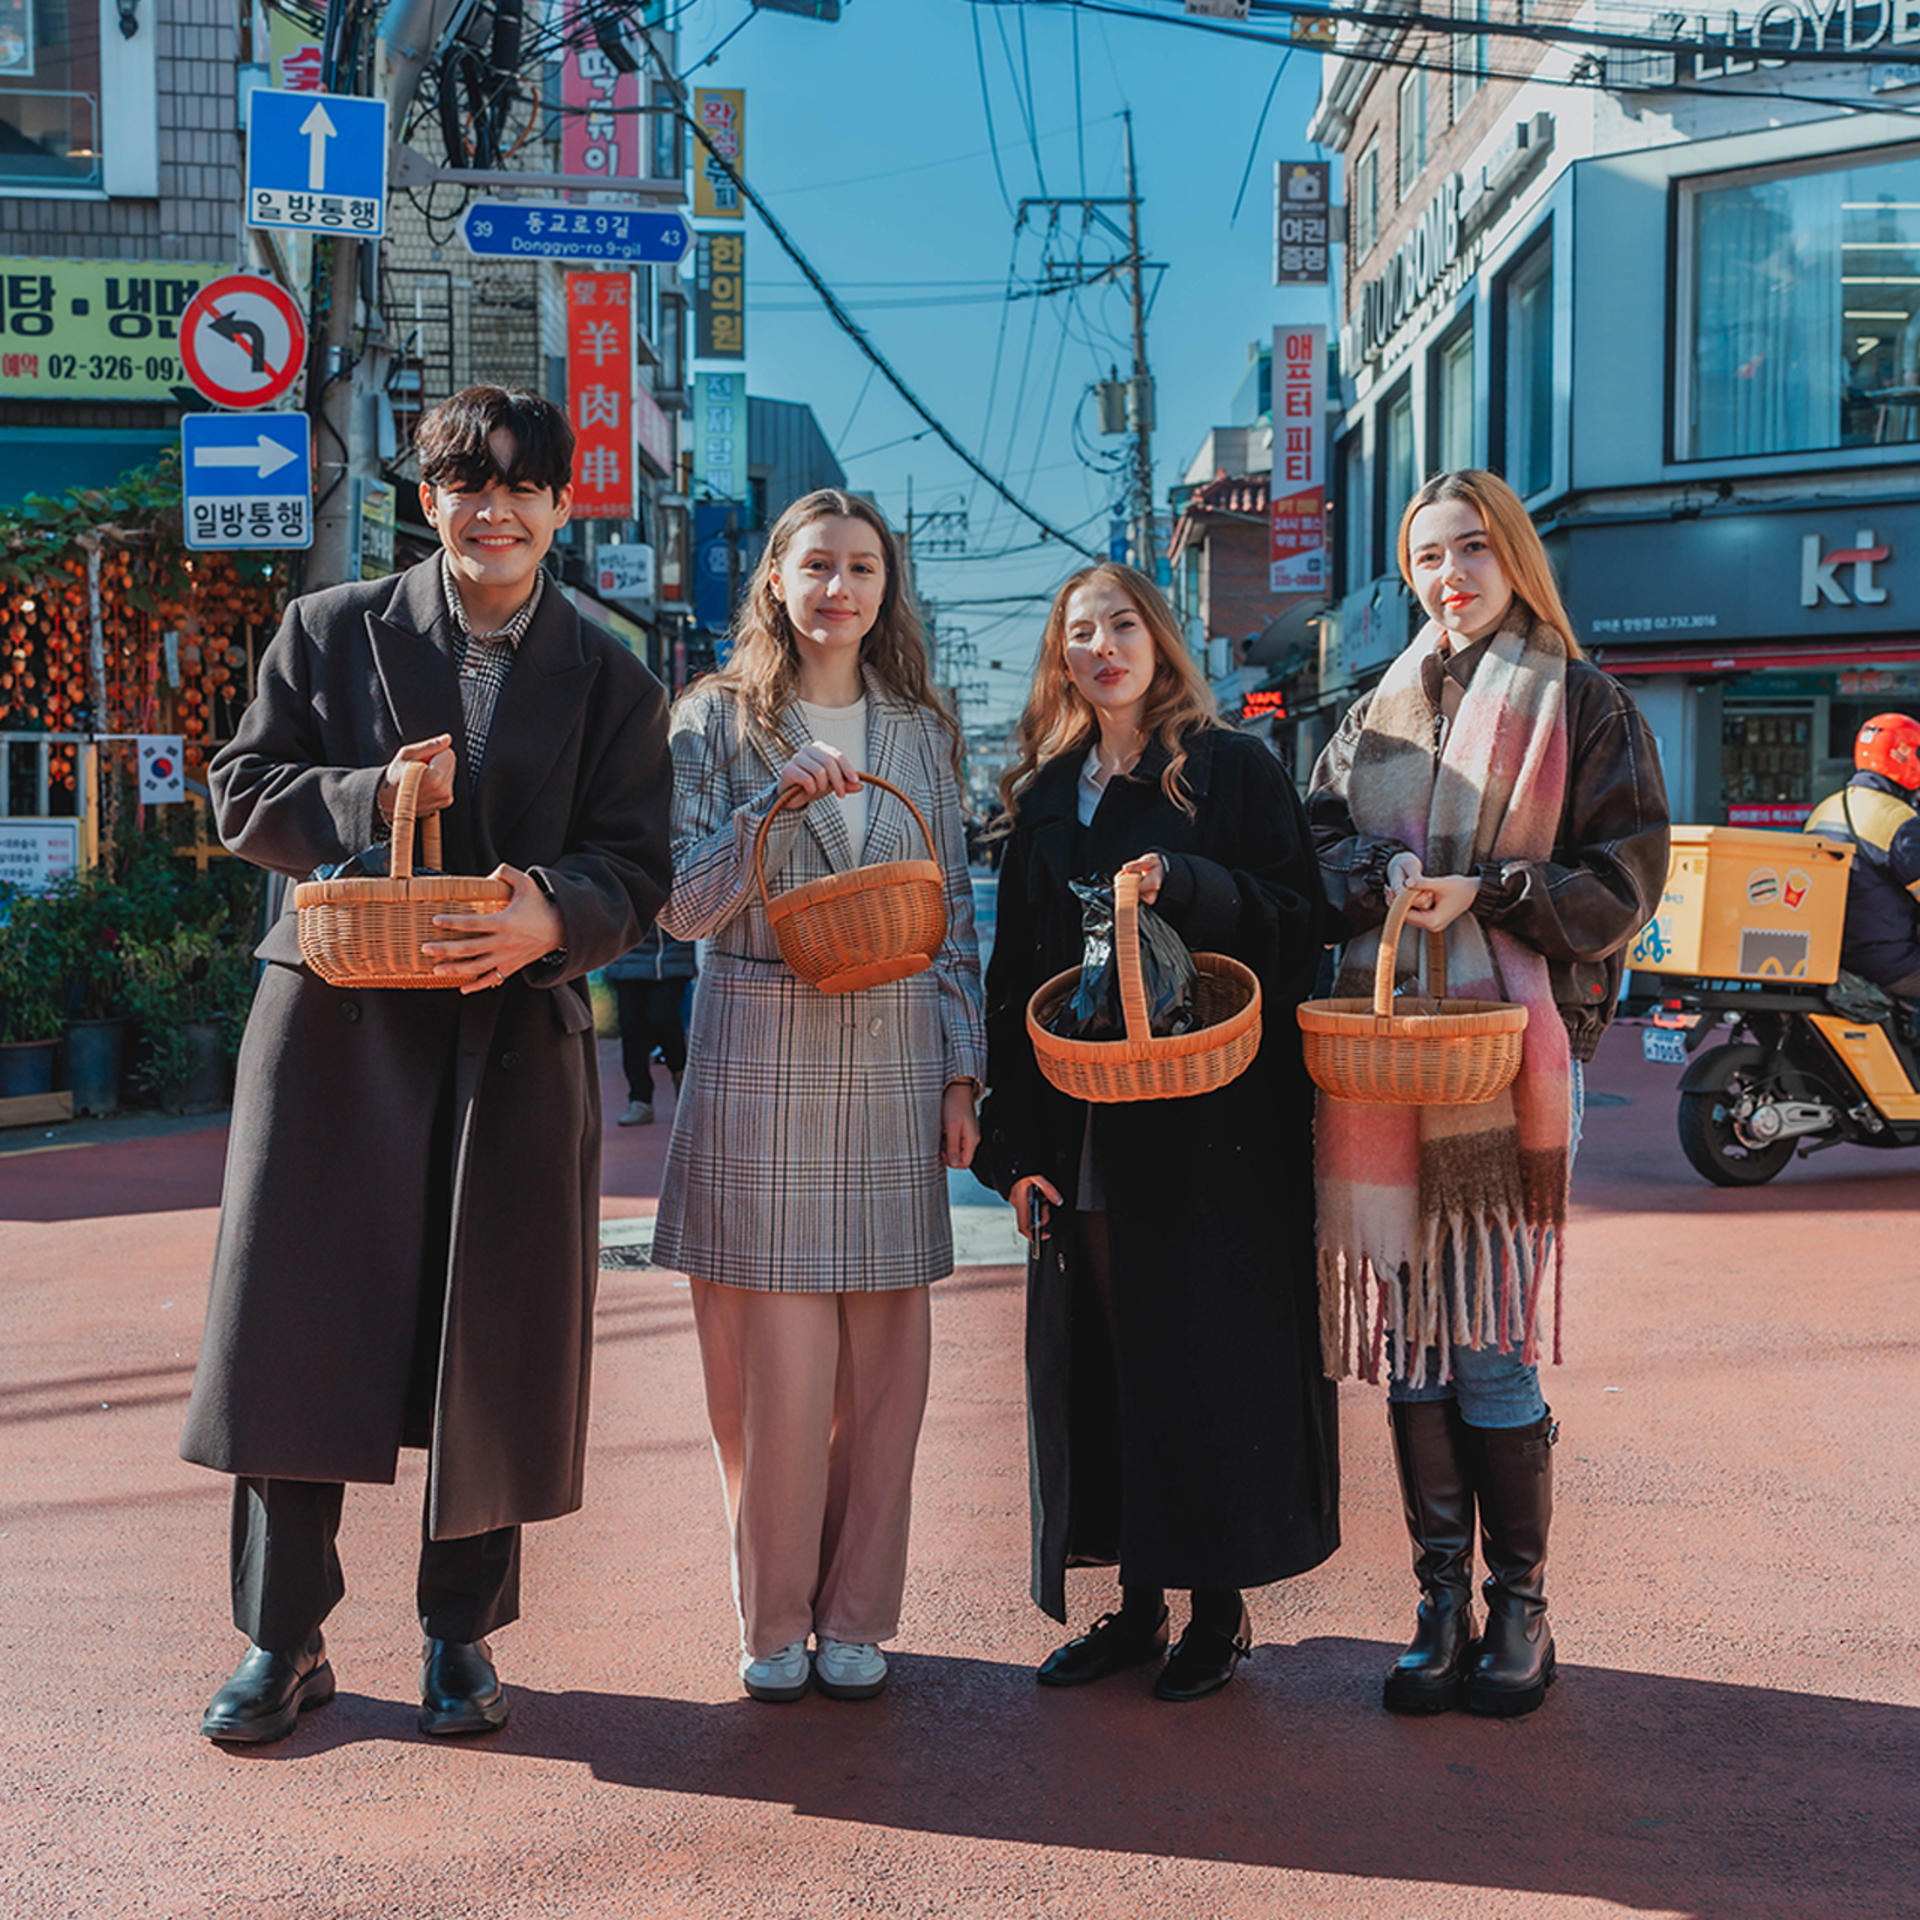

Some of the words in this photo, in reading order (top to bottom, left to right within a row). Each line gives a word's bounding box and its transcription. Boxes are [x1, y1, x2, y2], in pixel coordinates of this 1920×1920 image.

[257, 192, 375, 229] 일방통행
[472, 220, 493, 237] 39
[525, 211, 630, 239] 동교로9길
[512, 236, 602, 256] Donggyo-ro
[606, 242, 641, 258] 9-gil
[660, 230, 681, 247] 43
[1281, 218, 1325, 243] 여권
[711, 236, 743, 351] 한의원
[2, 352, 39, 379] 예약
[1285, 334, 1312, 418] 애프터
[576, 320, 621, 493] 羊肉串
[706, 373, 736, 500] 전자담배
[1285, 427, 1312, 482] 피티
[194, 502, 303, 539] 일방통행
[1801, 529, 1890, 608] kt
[1245, 690, 1283, 705] VAPE
